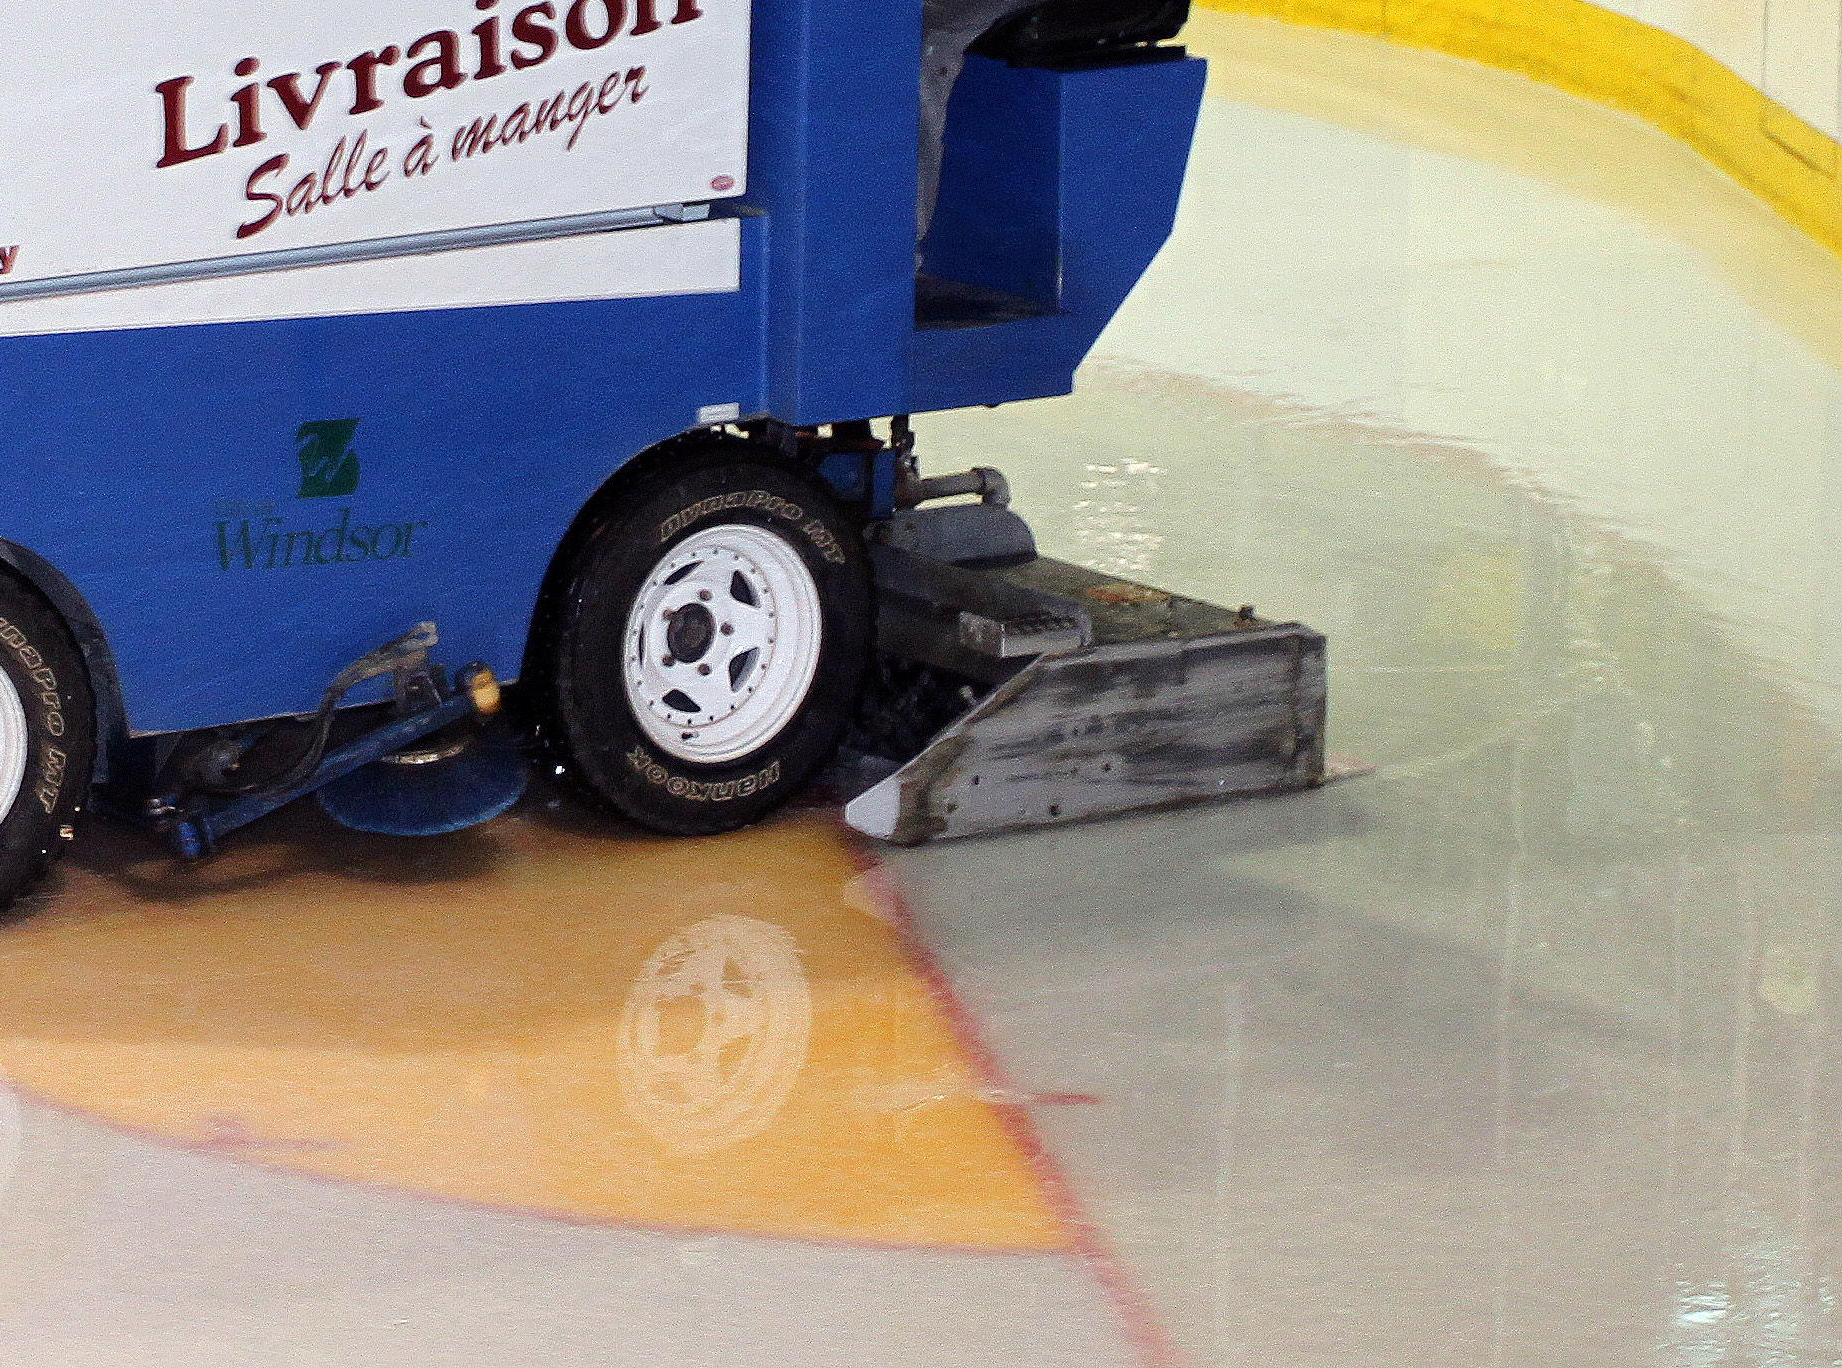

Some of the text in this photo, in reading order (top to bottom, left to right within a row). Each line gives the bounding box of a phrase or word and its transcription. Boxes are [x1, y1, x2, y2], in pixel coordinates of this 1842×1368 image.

[235, 63, 650, 240] Salle à manger
[212, 508, 428, 571] Windsor
